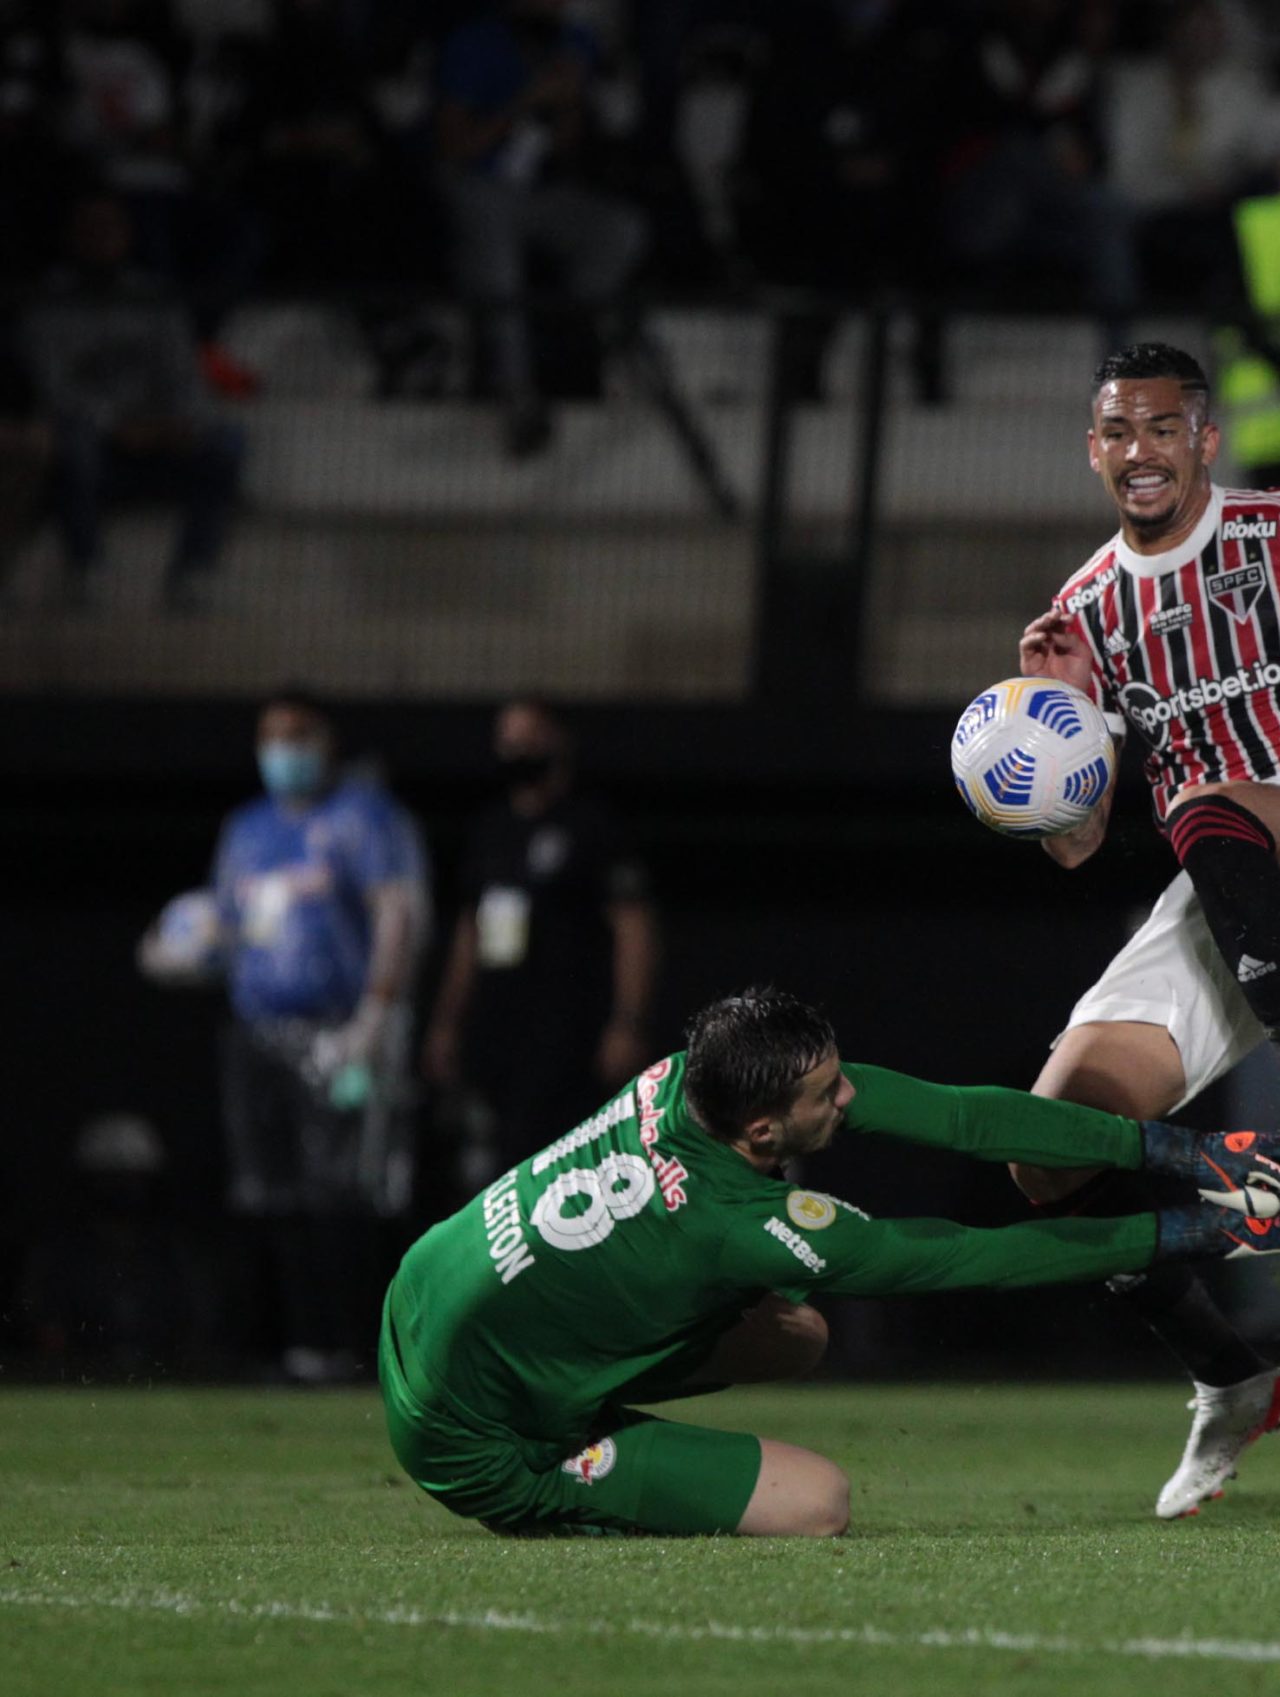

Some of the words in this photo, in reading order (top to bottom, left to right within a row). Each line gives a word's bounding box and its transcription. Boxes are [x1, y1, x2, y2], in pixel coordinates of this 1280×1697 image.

[1211, 567, 1259, 592] SPFC
[530, 1091, 655, 1251] 18
[763, 1215, 827, 1274] NetBet
